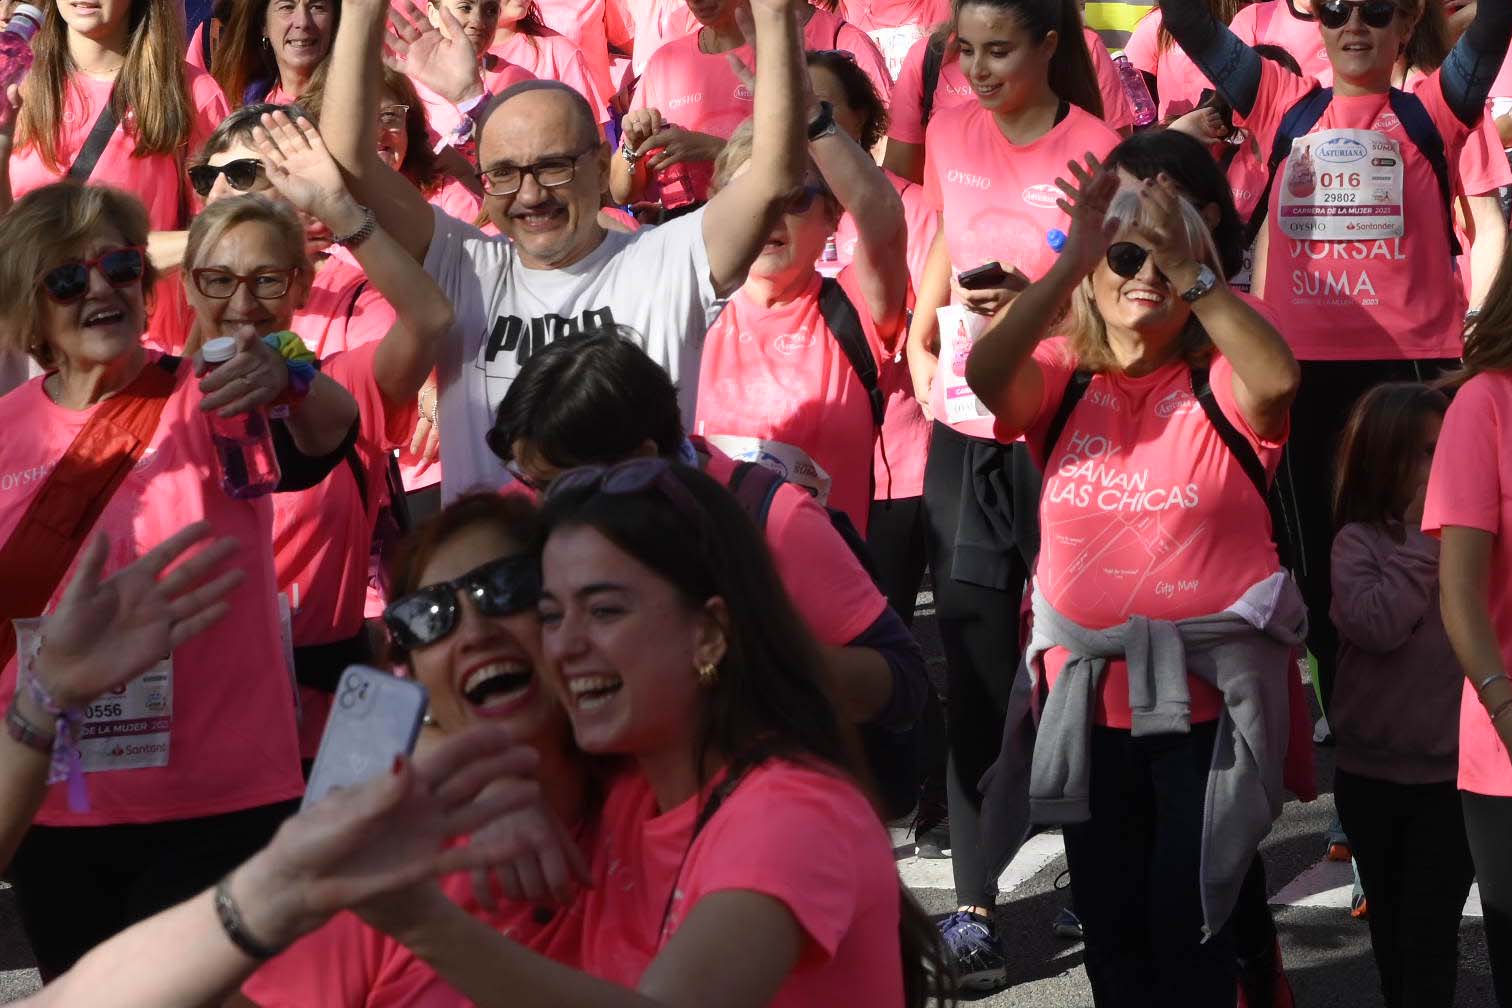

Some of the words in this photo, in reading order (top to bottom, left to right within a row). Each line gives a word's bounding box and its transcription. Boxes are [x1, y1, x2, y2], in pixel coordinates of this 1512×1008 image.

[1319, 148, 1364, 158] ASTURIANA
[947, 169, 991, 190] OYSHO
[1320, 172, 1361, 188] 016
[1324, 193, 1356, 203] 29802
[1292, 207, 1326, 215] CARRERA
[1327, 207, 1337, 215] DE
[1290, 223, 1326, 232] OYSHO
[1356, 222, 1396, 231] Santander
[1292, 270, 1376, 296] SUMA
[1066, 431, 1121, 462] HOY
[1058, 453, 1149, 490] GANAN
[1049, 479, 1093, 508] LAS
[1097, 483, 1200, 513] CHICAS
[1156, 580, 1175, 598] City
[113, 722, 149, 733] MUJER
